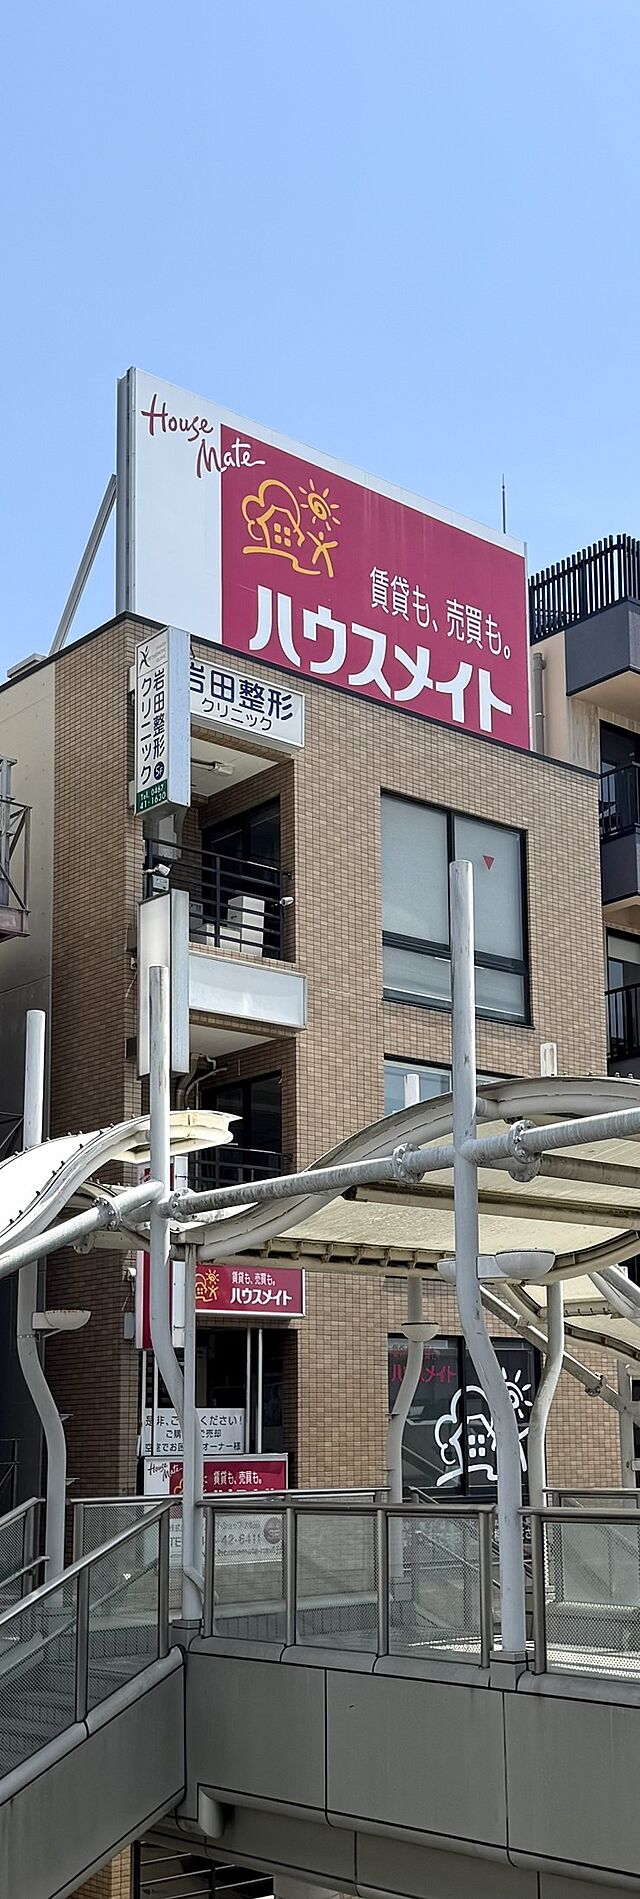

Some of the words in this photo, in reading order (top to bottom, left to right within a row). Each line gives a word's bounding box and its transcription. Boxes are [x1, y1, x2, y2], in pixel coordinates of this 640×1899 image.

[141, 393, 214, 442] House
[196, 437, 266, 478] Mate
[370, 566, 512, 660] 賃貸も、売買も。
[249, 584, 512, 733] ハウスメイト
[140, 677, 152, 786] クリニック
[153, 667, 166, 760] 岩田整形
[202, 697, 272, 731] クリニック
[230, 1287, 293, 1306] ハウスメイト
